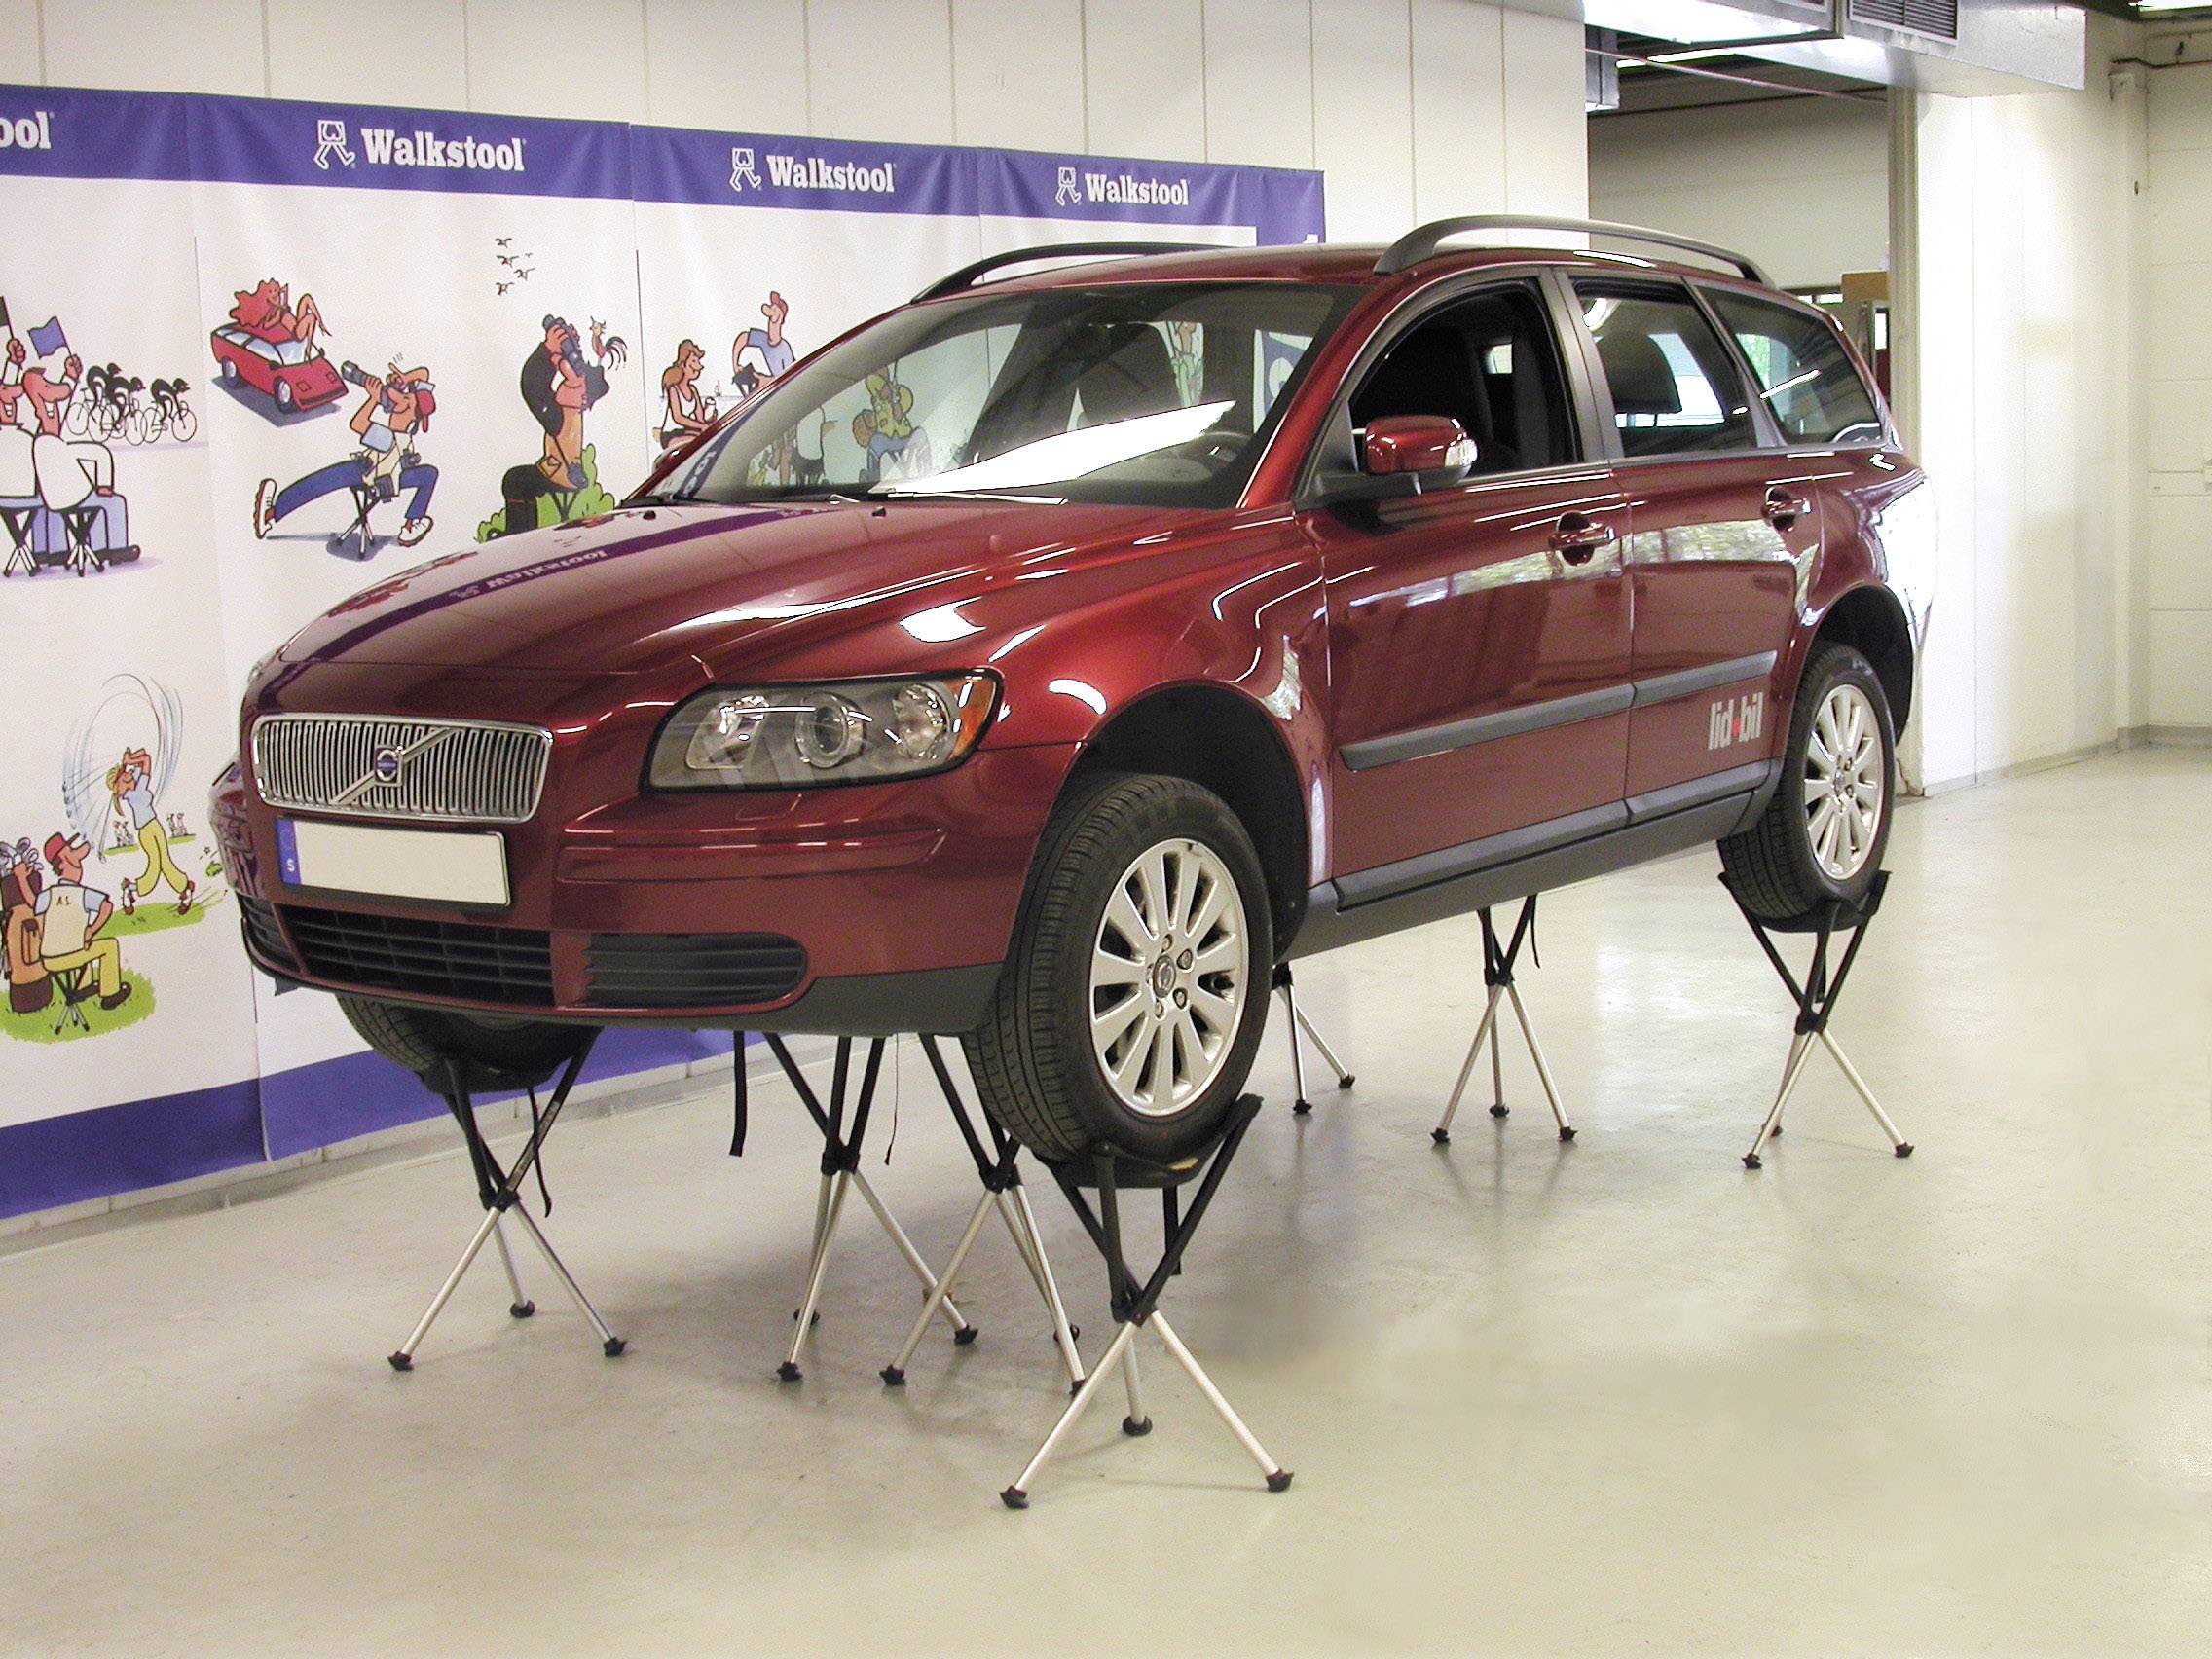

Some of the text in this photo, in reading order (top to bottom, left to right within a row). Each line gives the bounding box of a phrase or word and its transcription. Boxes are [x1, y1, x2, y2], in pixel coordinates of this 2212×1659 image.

[360, 128, 525, 172] Walkstool
[766, 154, 895, 193] Walkstool
[1084, 172, 1189, 206] Walkstool
[286, 858, 295, 872] S
